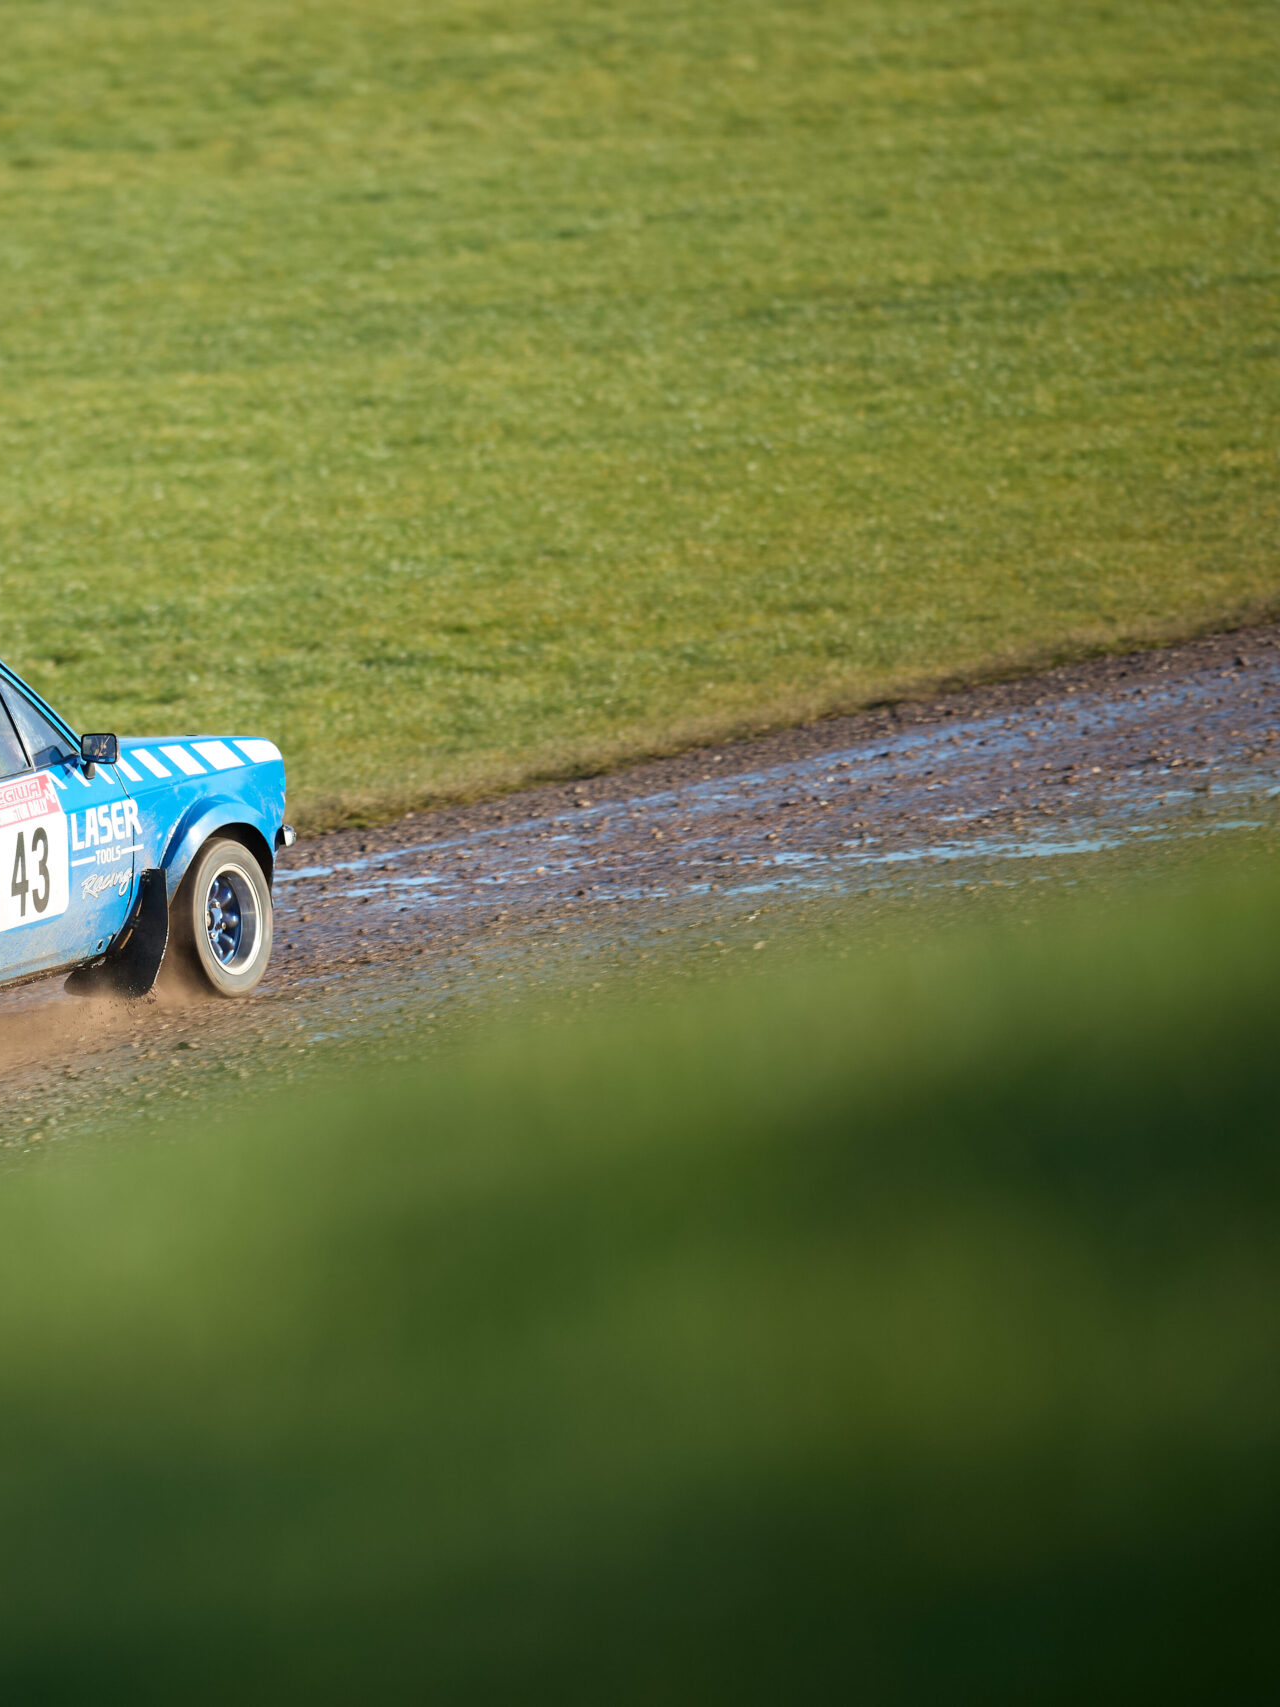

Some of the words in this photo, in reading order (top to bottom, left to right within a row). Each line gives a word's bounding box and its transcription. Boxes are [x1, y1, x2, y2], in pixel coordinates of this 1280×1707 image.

[70, 798, 143, 852] LASER
[11, 827, 50, 917] 43
[95, 845, 121, 865] TOOLS
[81, 867, 133, 900] Racing
